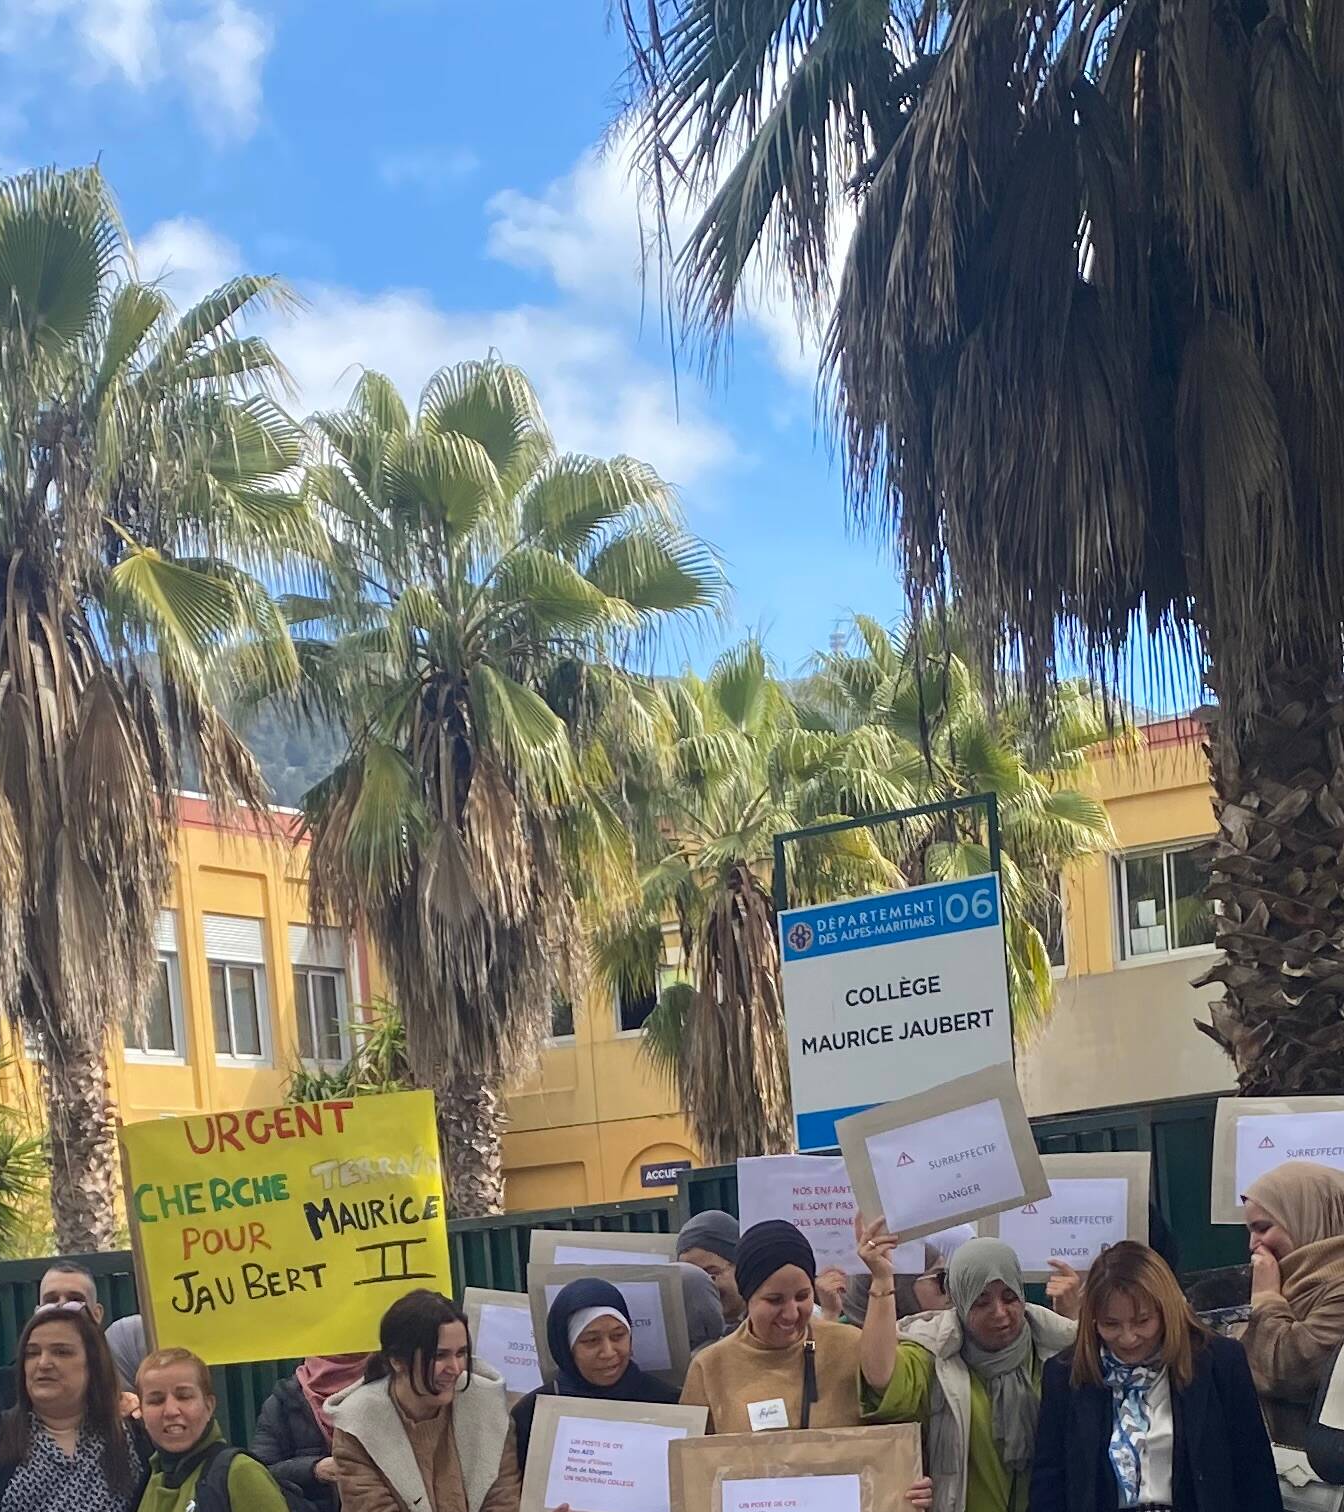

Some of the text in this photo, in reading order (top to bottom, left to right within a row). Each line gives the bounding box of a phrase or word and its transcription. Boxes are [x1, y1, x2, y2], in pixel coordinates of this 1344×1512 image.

[817, 899, 935, 932] DÉPARTEMENT
[945, 888, 993, 923] 06
[818, 915, 936, 946] DES ALPES-MARITIMES
[845, 975, 942, 1007] COLLÈGE
[802, 1009, 994, 1055] MAURICE JAUBERT
[185, 1101, 354, 1155] URGENT
[928, 1142, 998, 1171] SURREFFECTIF
[646, 1168, 680, 1181] ACCUE
[134, 1173, 290, 1223] CHERCHE
[792, 1185, 853, 1196] NOS ENFANT
[808, 1201, 833, 1211] SONT
[835, 1201, 854, 1210] PAS
[938, 1183, 982, 1204] DANGER
[813, 1217, 854, 1227] SARDINE
[1049, 1215, 1115, 1225] SURREFFECTIF
[181, 1222, 272, 1261] POUR
[1050, 1247, 1089, 1257] DANGER
[353, 1237, 437, 1287] II
